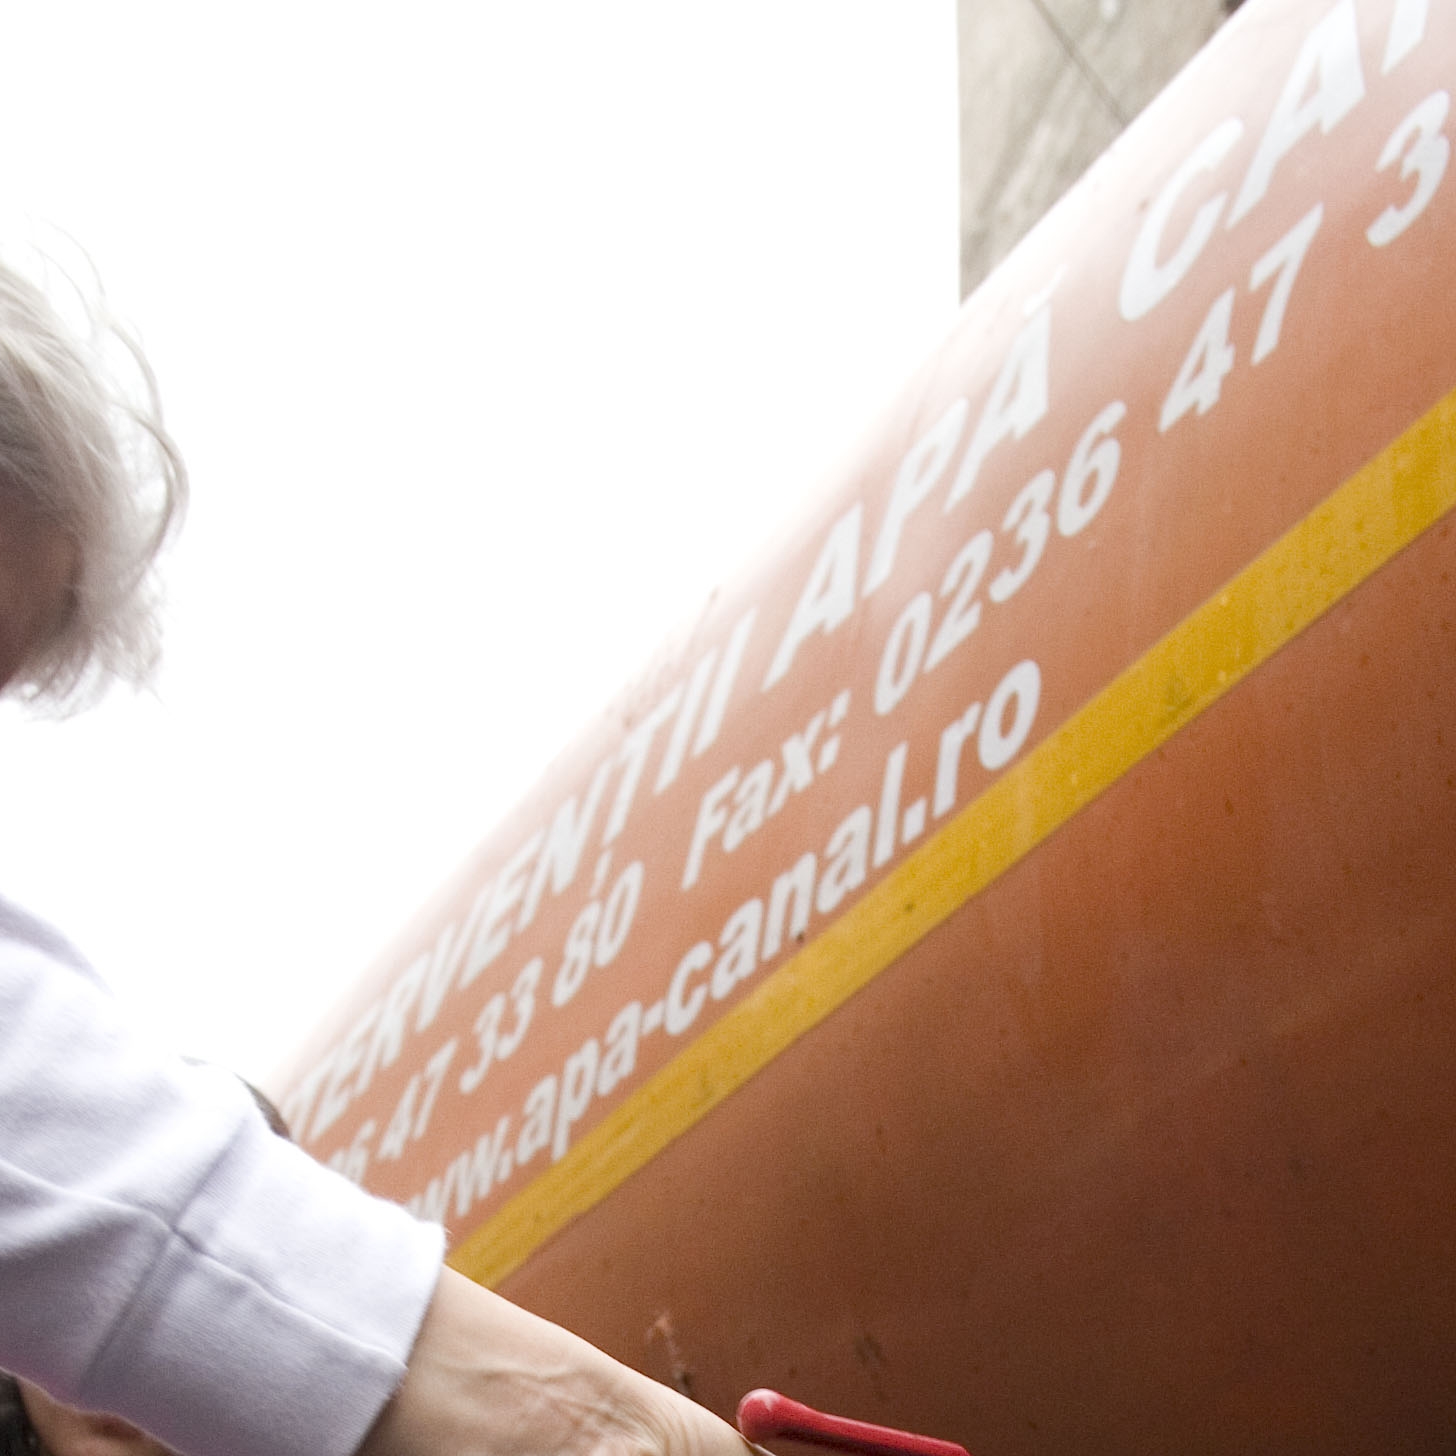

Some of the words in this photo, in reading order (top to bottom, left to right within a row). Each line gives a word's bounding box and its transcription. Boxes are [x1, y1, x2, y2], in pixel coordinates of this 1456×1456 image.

[374, 1036, 460, 1163] 47
[459, 955, 544, 1095] 33
[551, 860, 644, 1007] 80
[680, 689, 852, 890] Fax:
[873, 400, 1127, 716] 0236
[1157, 203, 1325, 433] 47
